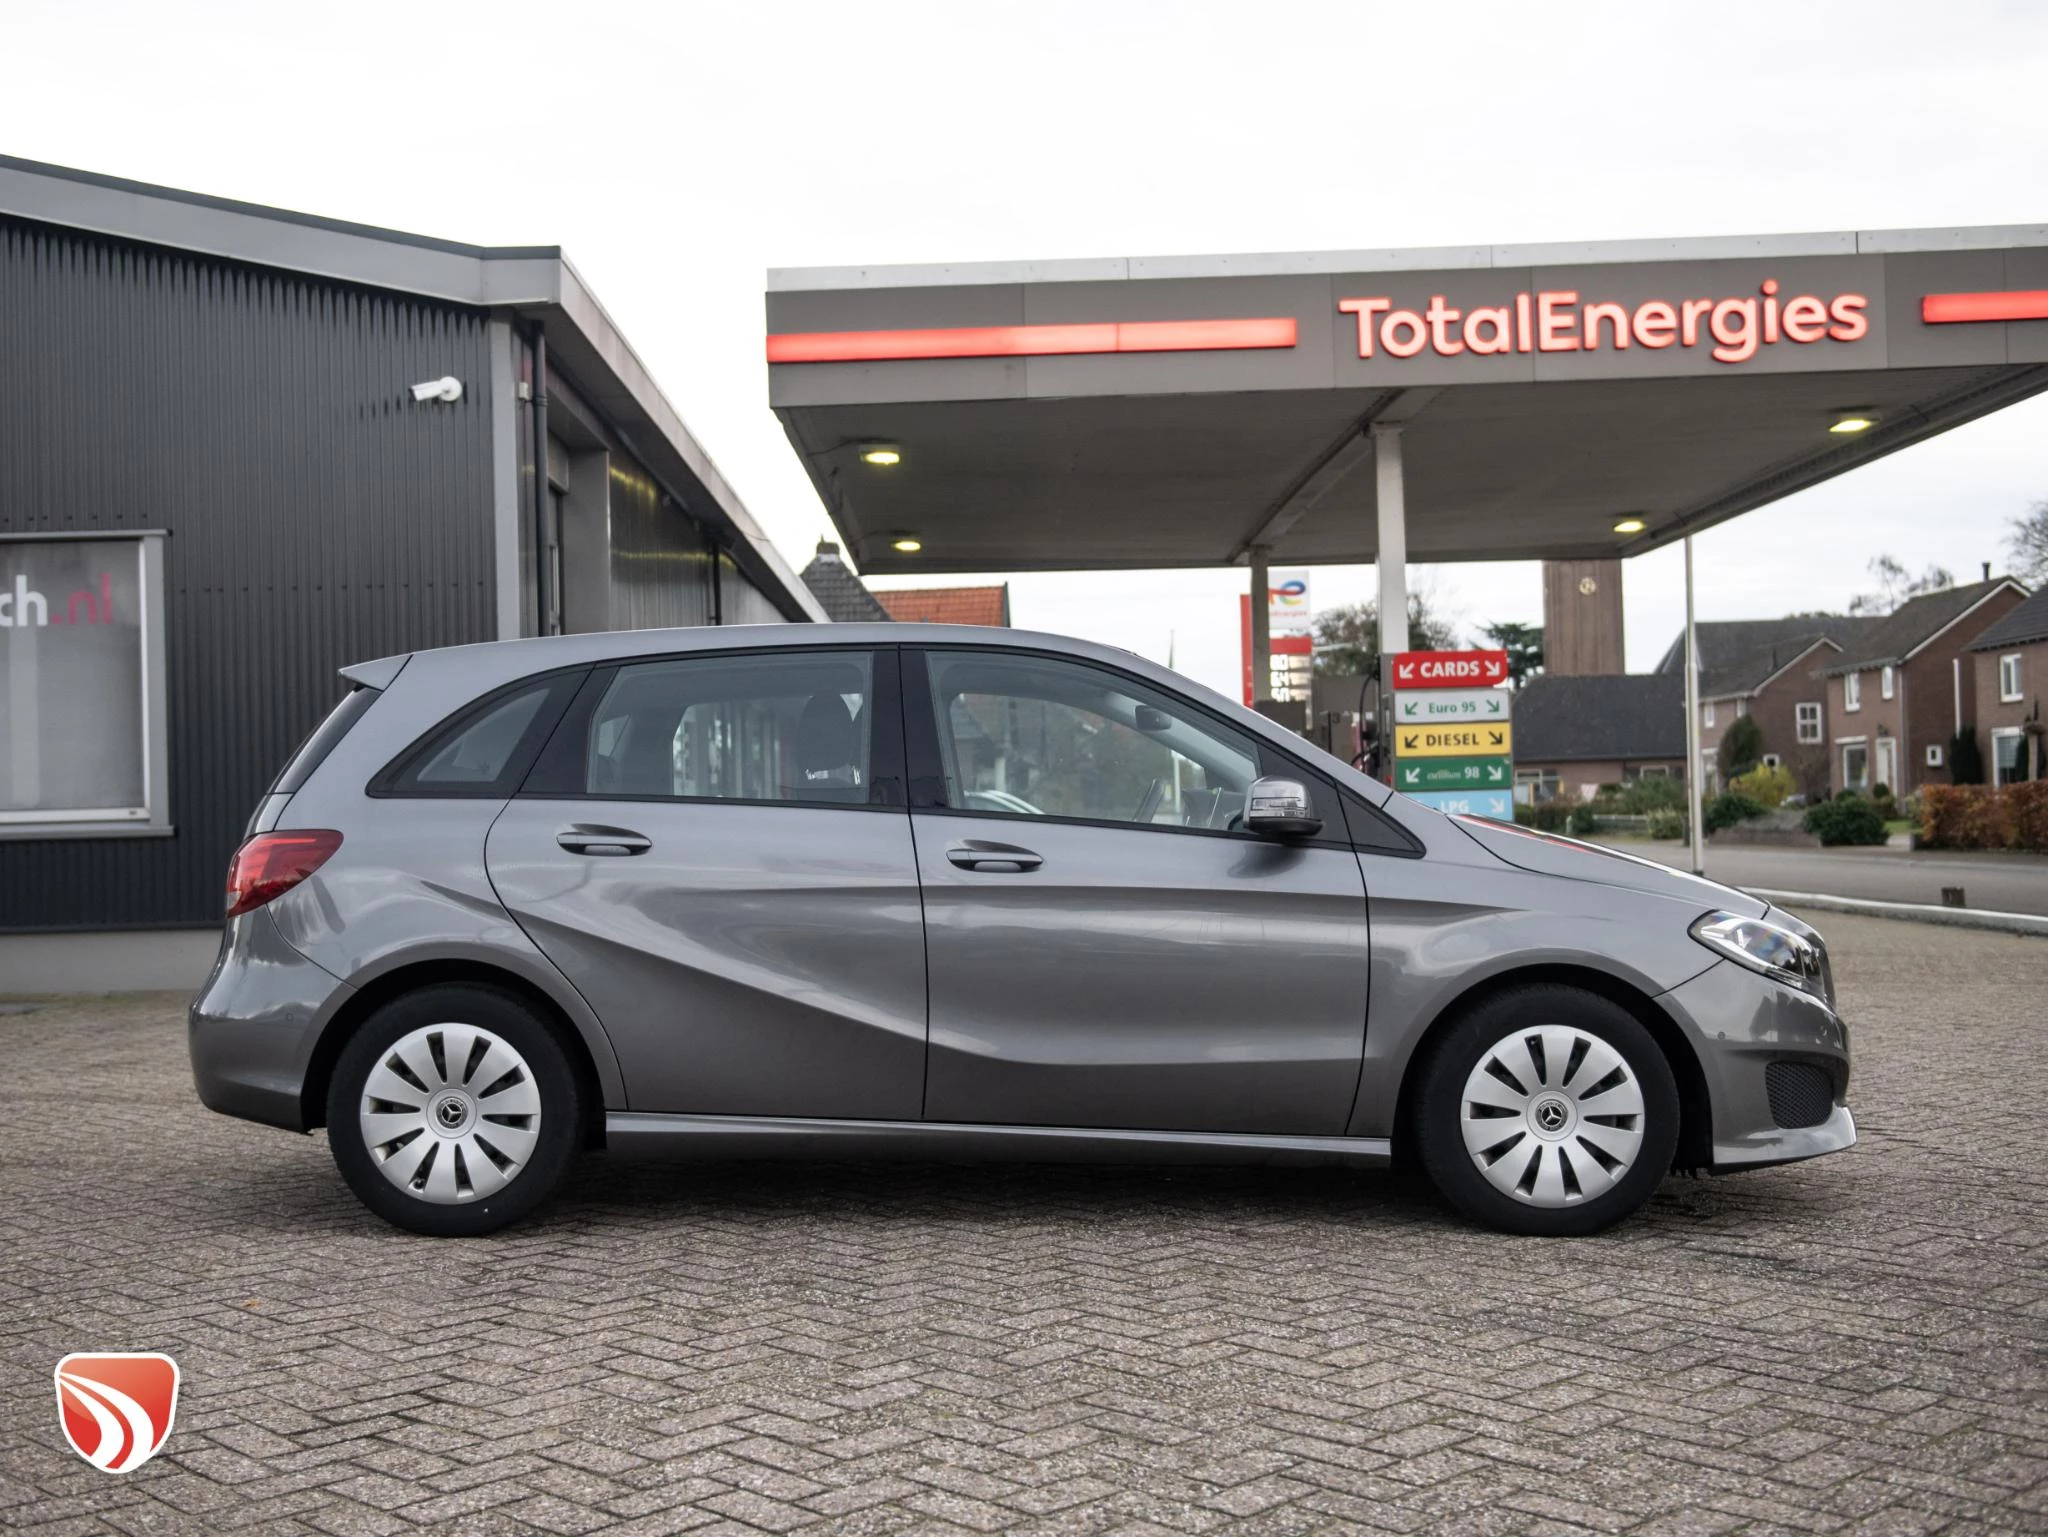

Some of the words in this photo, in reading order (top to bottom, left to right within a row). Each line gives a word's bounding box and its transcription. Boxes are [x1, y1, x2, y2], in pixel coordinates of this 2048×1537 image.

[1338, 278, 1868, 363] TotalEnergies
[1420, 660, 1480, 678] CARDS
[1428, 702, 1458, 714] Euro
[1461, 701, 1477, 713] 95
[1426, 733, 1480, 747] DIESEL
[1464, 766, 1480, 779] 98
[1440, 799, 1469, 814] LPG
